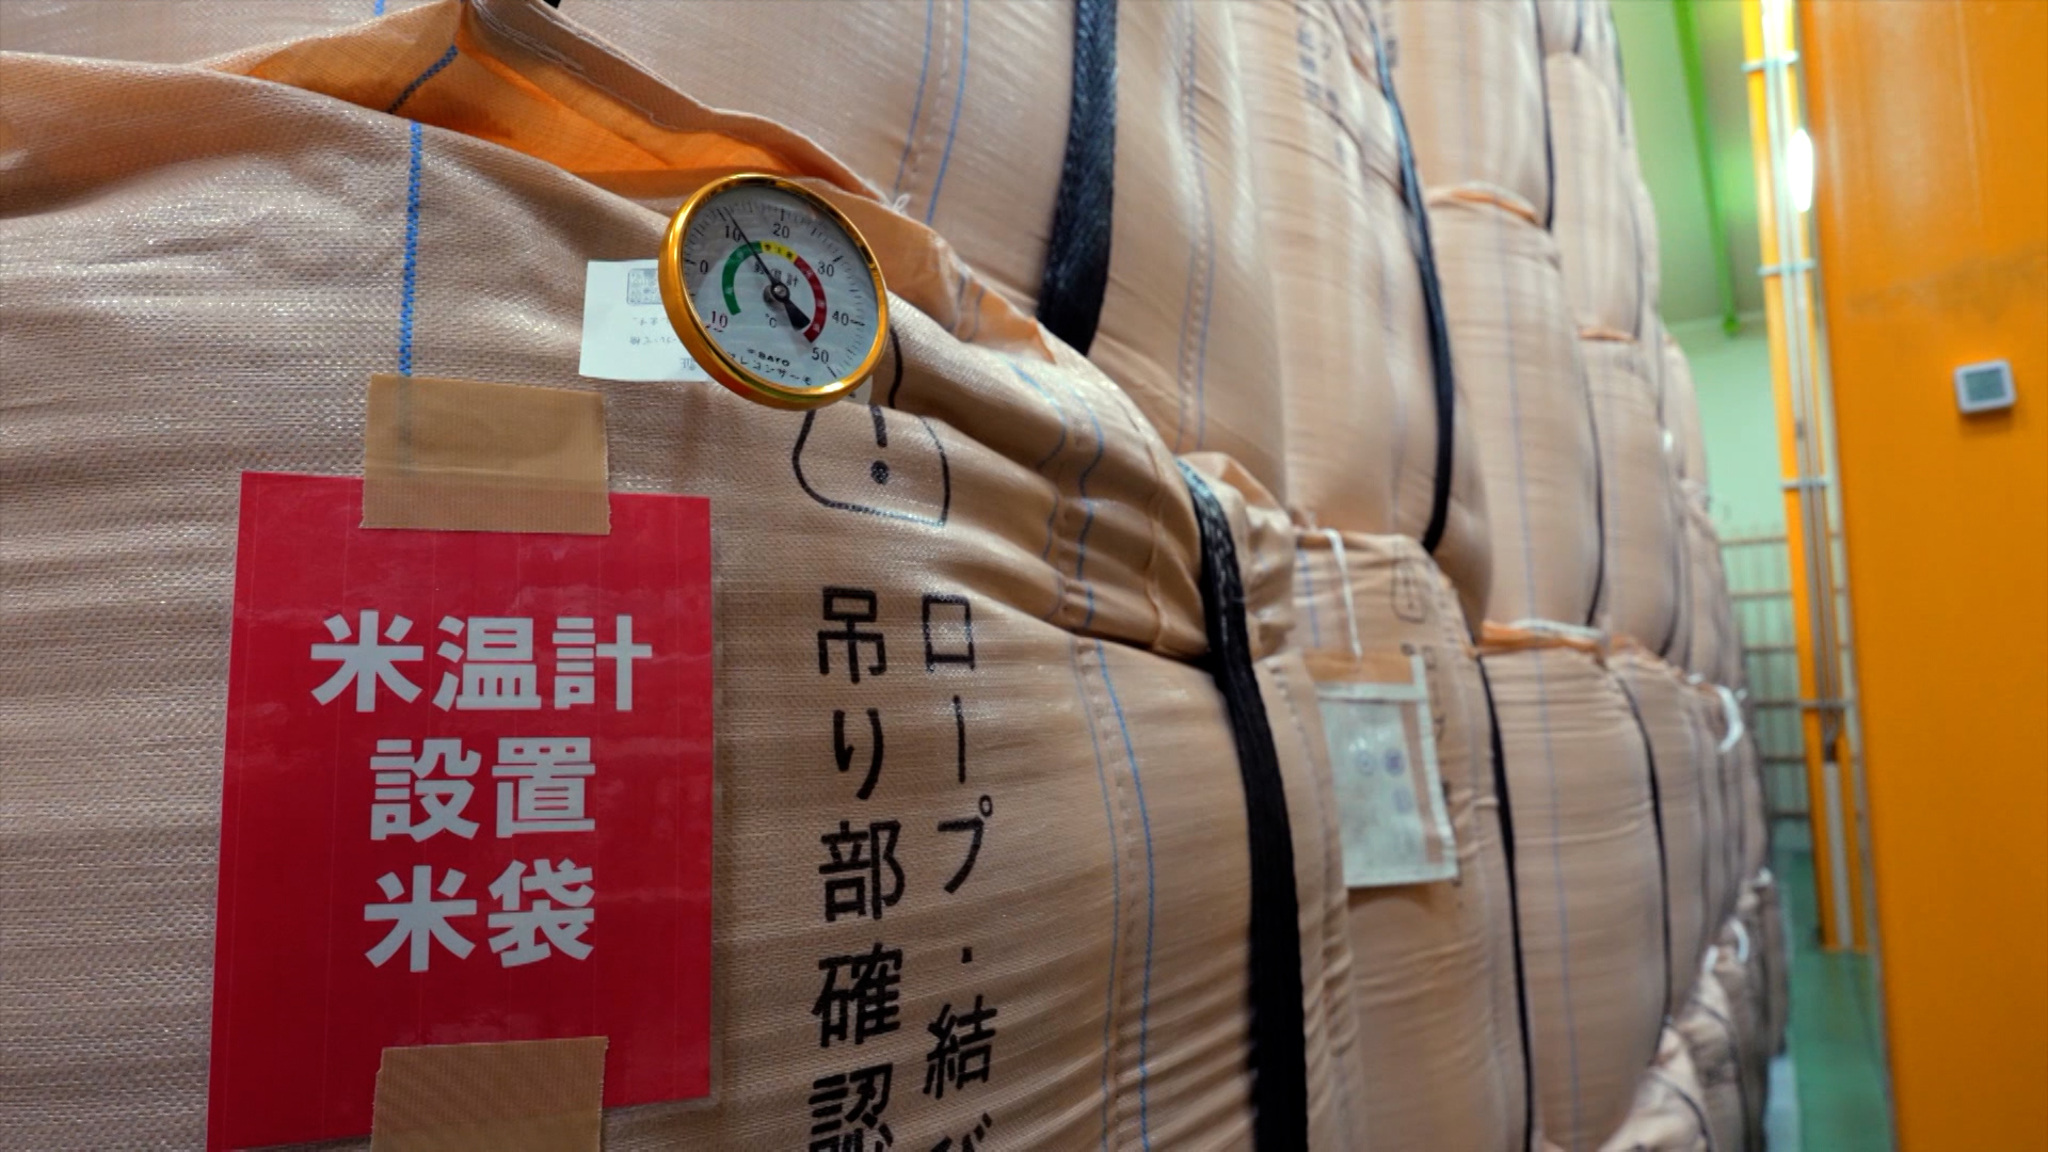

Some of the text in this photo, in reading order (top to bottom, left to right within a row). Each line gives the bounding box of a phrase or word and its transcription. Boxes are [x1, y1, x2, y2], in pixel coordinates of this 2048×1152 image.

[773, 223, 790, 239] 20
[700, 260, 709, 274] 0
[818, 261, 835, 277] 30
[832, 312, 849, 326] 40
[811, 347, 830, 364] 50
[310, 609, 653, 713] 米温計
[370, 737, 596, 843] 設置
[363, 858, 596, 973] 米袋
